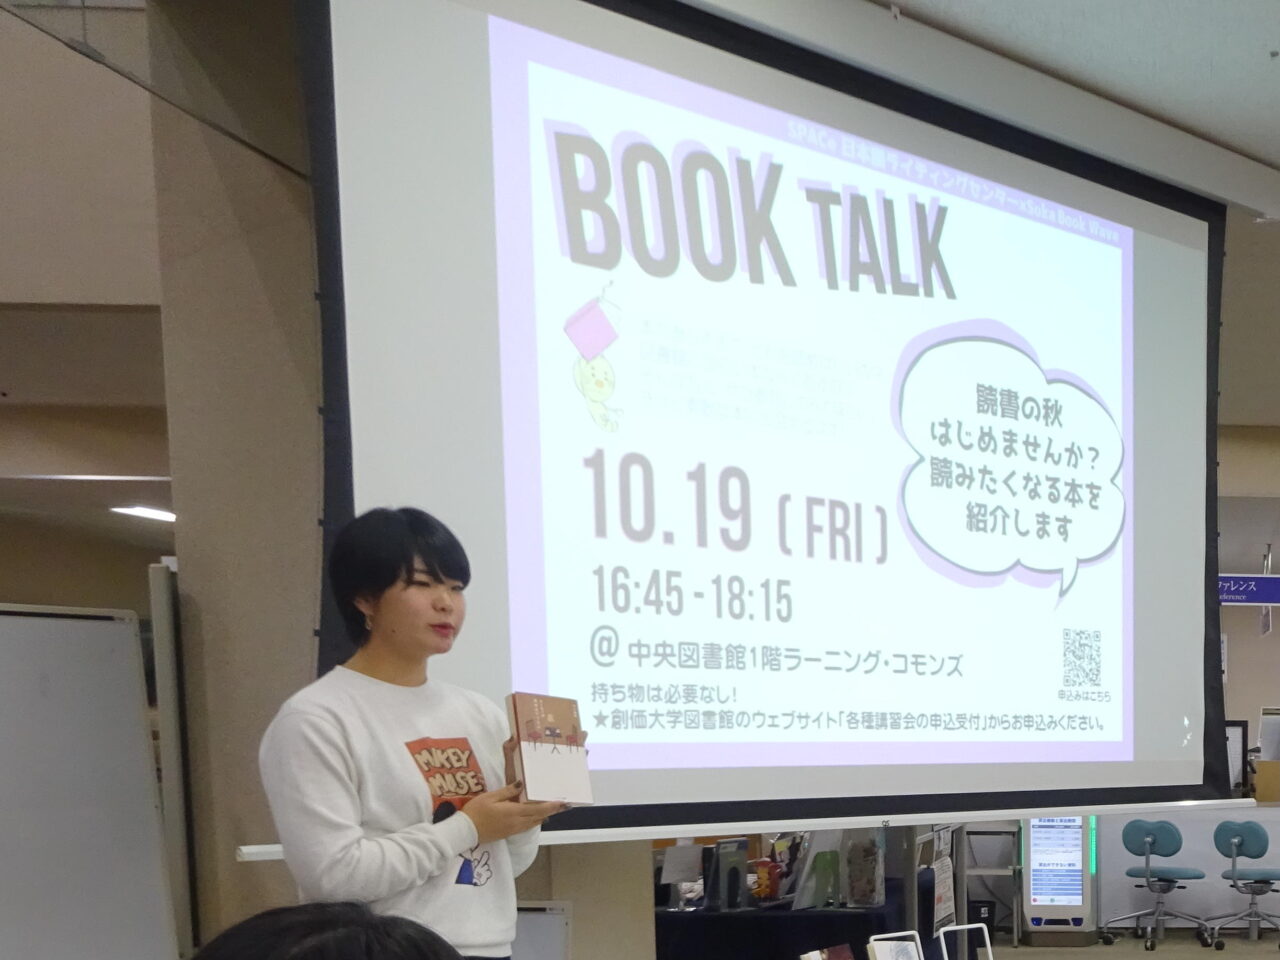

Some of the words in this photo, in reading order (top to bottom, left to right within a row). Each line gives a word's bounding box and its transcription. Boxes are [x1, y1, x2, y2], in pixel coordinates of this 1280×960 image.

[554, 131, 797, 287] BOOK
[805, 187, 957, 299] TALK
[976, 383, 1063, 428] 読書の秋
[930, 418, 1100, 470] はじめませんか?
[583, 448, 751, 552] 10.19
[930, 455, 1102, 510] 読みたくなる本を
[966, 501, 1073, 542] 紹介します
[591, 682, 738, 704] 持ち物は必要なし!
